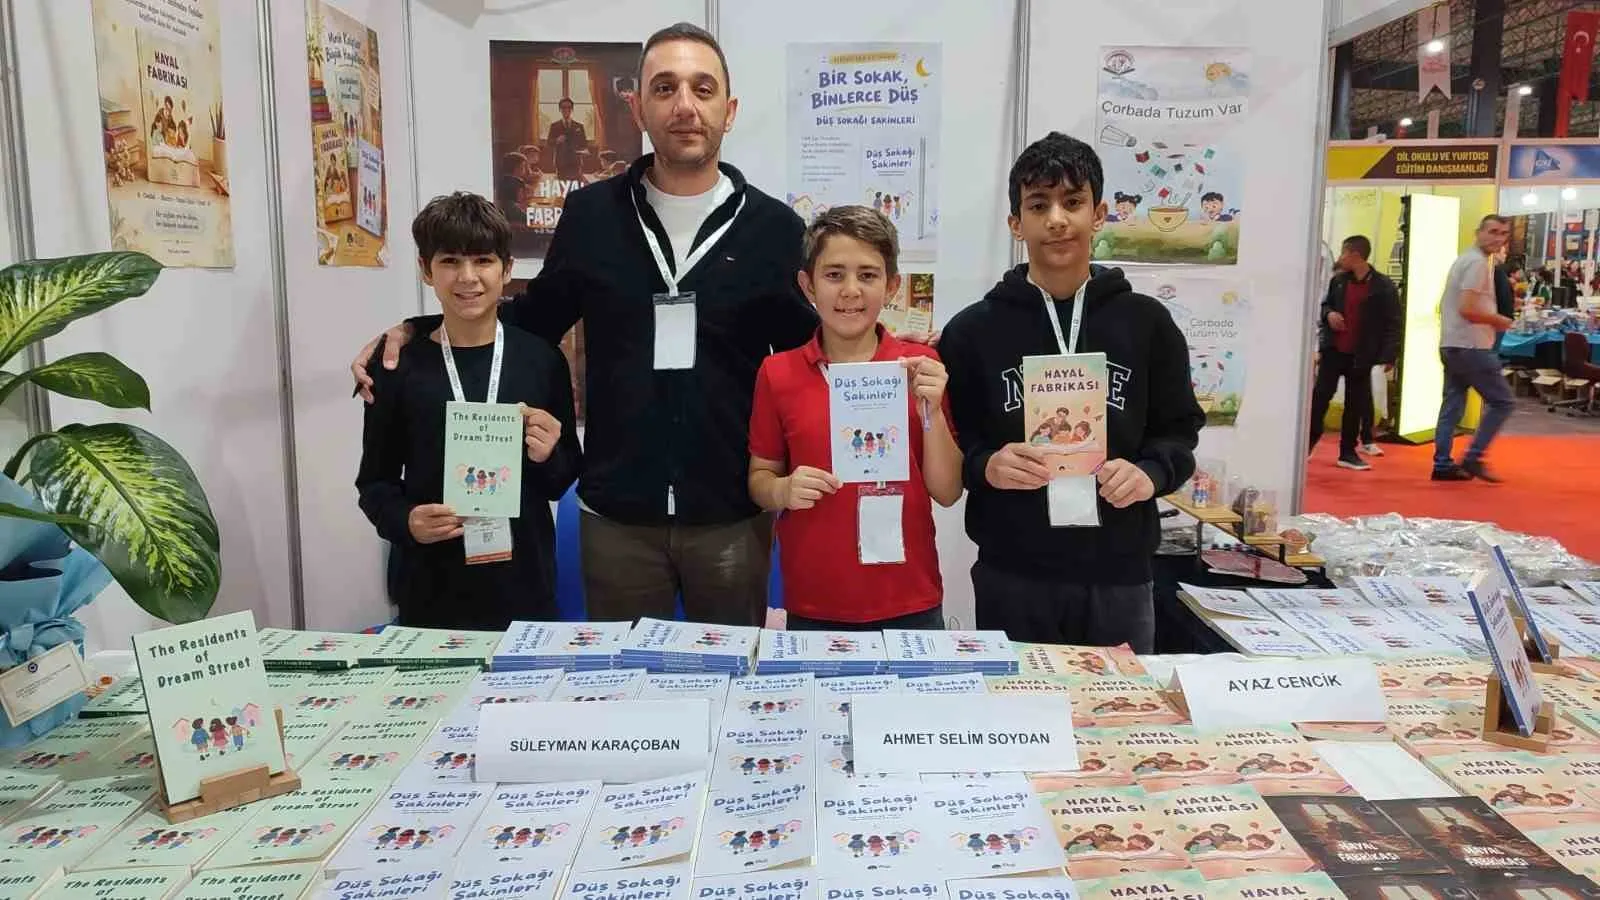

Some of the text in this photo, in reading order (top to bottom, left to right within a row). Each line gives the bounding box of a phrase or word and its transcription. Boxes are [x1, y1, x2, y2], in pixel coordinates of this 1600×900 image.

[154, 51, 180, 70] HAYAL
[818, 68, 909, 89] BİR SOKAK,
[811, 86, 919, 110] BİNLERCE DÜŞ
[1101, 100, 1243, 119] Çorbada Tuzum Var
[816, 115, 834, 127] DÜŞ
[1411, 152, 1439, 162] OKULU
[1439, 152, 1451, 162] VE
[1044, 368, 1086, 379] HAYAL
[834, 375, 902, 390] Düş Sokağı
[843, 390, 898, 402] Sakinleri
[452, 412, 516, 423] The Residents
[452, 433, 513, 442] Dream Street
[148, 644, 176, 659] The
[179, 628, 248, 653] Residents
[194, 650, 210, 664] of
[157, 656, 252, 689] Dream Street
[1228, 672, 1342, 692] AYAZ CENCİK
[725, 731, 754, 739] Düş
[735, 736, 802, 745] Sakinleri
[883, 731, 1050, 745] AHMET SELİM SOYDAN
[1226, 731, 1275, 739] HAYAL
[510, 738, 681, 753] SÜLEYMAN KARAÇOBAN
[1462, 760, 1518, 768] HAYAL
[389, 791, 483, 800] Düş Sokağı
[497, 789, 590, 801] Düş Sokağı
[604, 782, 697, 803] Düş Sokağı
[713, 784, 807, 807] Düş Sokağı
[394, 799, 470, 809] Sakinleri
[504, 798, 580, 809] Sakinleri
[613, 794, 688, 810] Sakinleri
[724, 795, 800, 814] Sakinleri
[823, 795, 919, 809] Düş Sokağı
[934, 793, 1029, 809] Düş Sokağı
[1065, 795, 1122, 806] HAYAL
[1176, 795, 1233, 806] HAYAL
[836, 805, 914, 816] Sakinleri
[947, 802, 1026, 817] Sakinleri
[64, 876, 169, 890] The Residents
[199, 872, 304, 886] The Residents
[333, 871, 443, 891] Düş Sokağı
[489, 871, 553, 885] Sokağı
[571, 876, 681, 893] Düş Sokağı
[95, 888, 115, 896] of
[339, 885, 429, 900] Sakinleri
[583, 891, 671, 900] Sakinleri
[698, 887, 736, 898] Düş
[743, 879, 809, 895] Sokağı
[827, 884, 938, 900] Düş Sokağı
[958, 890, 998, 900] Düş
[1109, 884, 1176, 897] HAYAL
[1239, 887, 1306, 900] HAYAL
